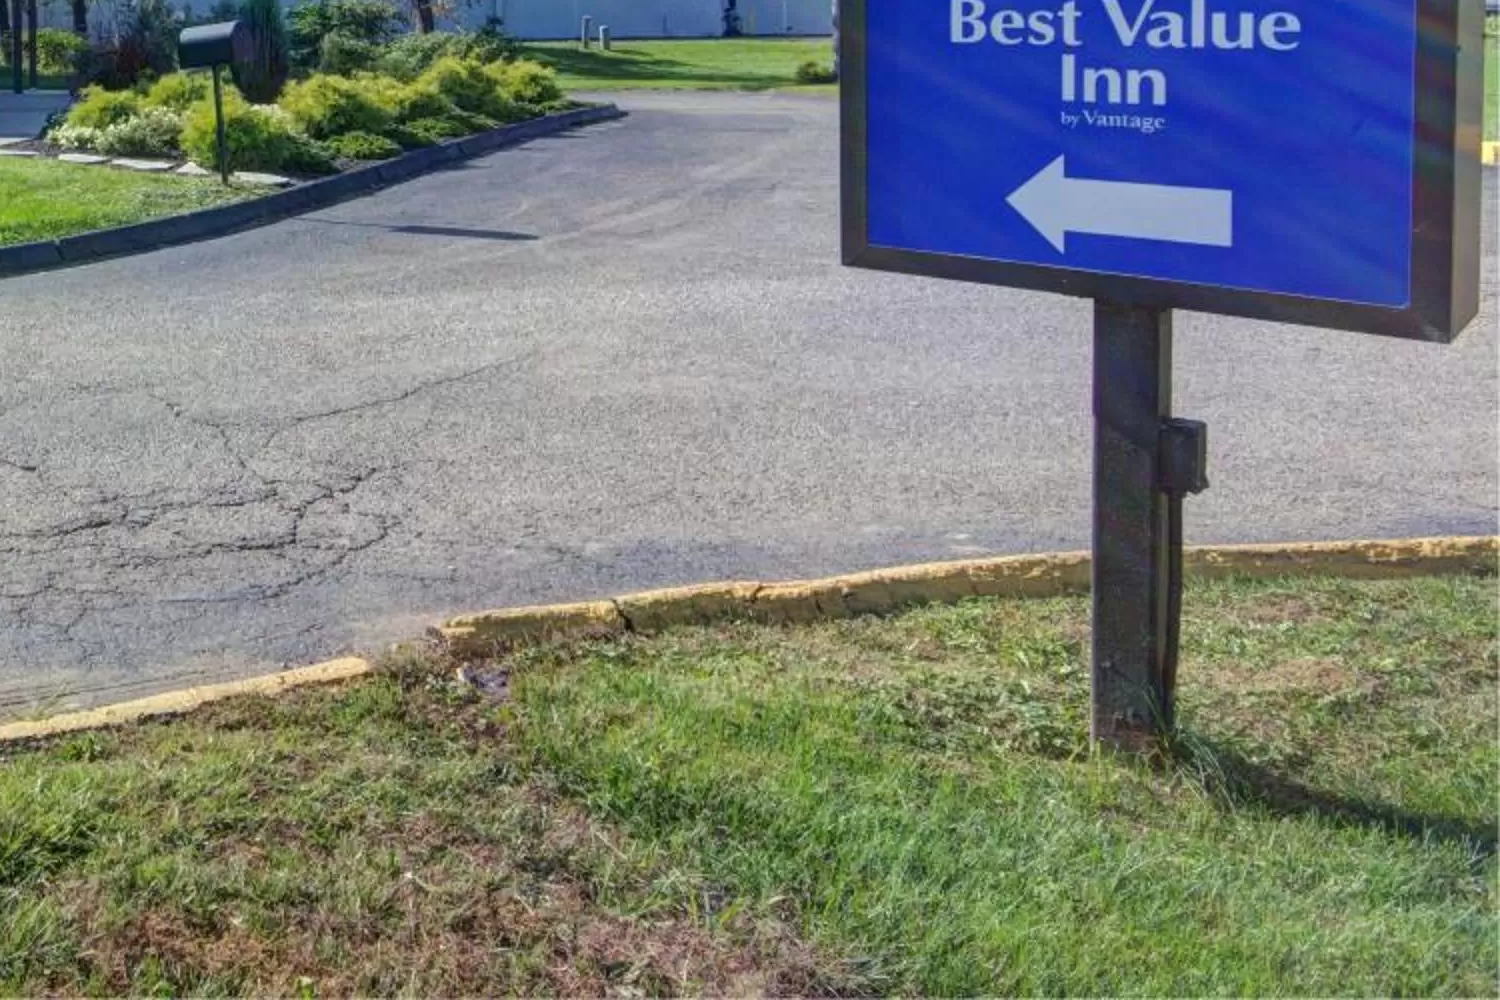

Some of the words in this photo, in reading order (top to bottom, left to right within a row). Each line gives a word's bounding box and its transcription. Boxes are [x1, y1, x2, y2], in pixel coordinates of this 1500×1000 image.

[1062, 53, 1166, 105] Inn
[1061, 111, 1079, 128] by
[1082, 110, 1165, 133] Vantage
